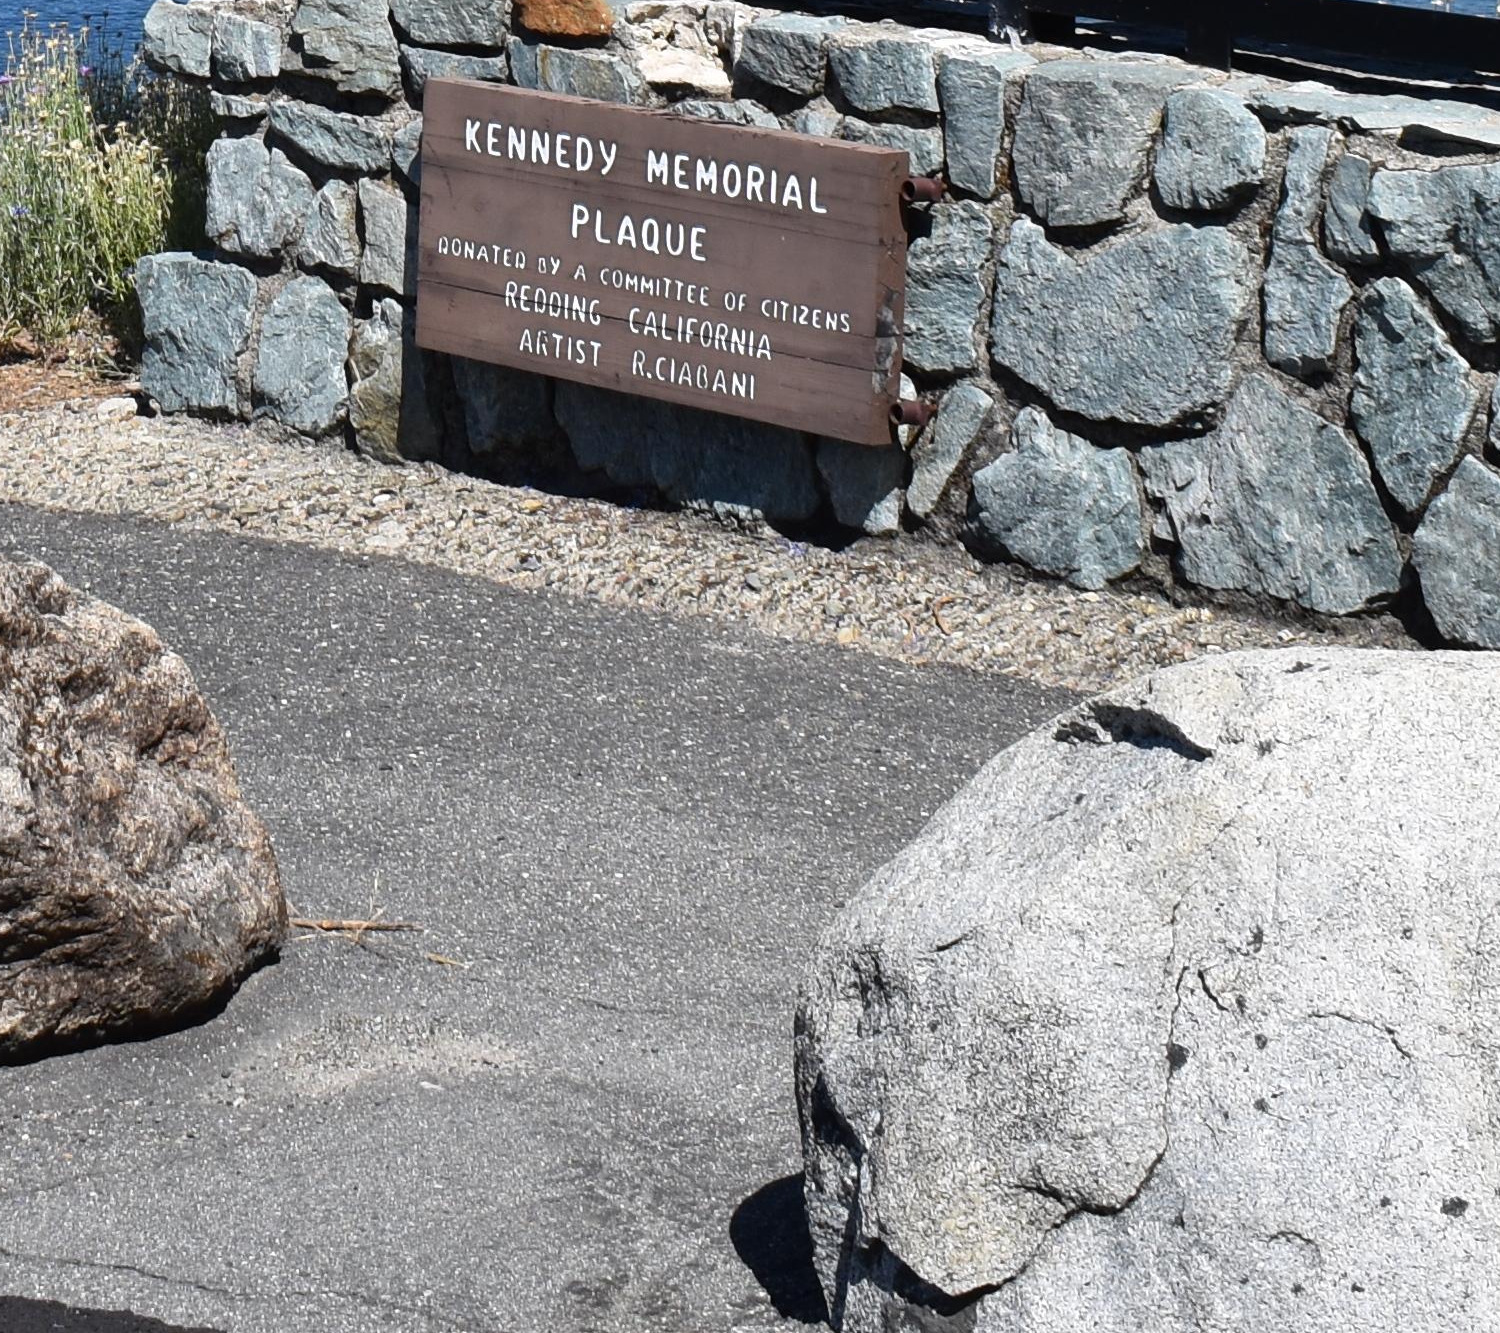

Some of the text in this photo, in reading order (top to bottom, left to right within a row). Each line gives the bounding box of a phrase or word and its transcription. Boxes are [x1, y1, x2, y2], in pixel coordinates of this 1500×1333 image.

[465, 118, 827, 214] KENNEDY MEMORIAL
[572, 204, 707, 262] PLAQUE
[438, 236, 851, 333] DONATED BY A COMMITTEE OF CITIZENS
[504, 281, 772, 361] REDDING CALIFORNIA
[519, 329, 601, 367] ARTIST
